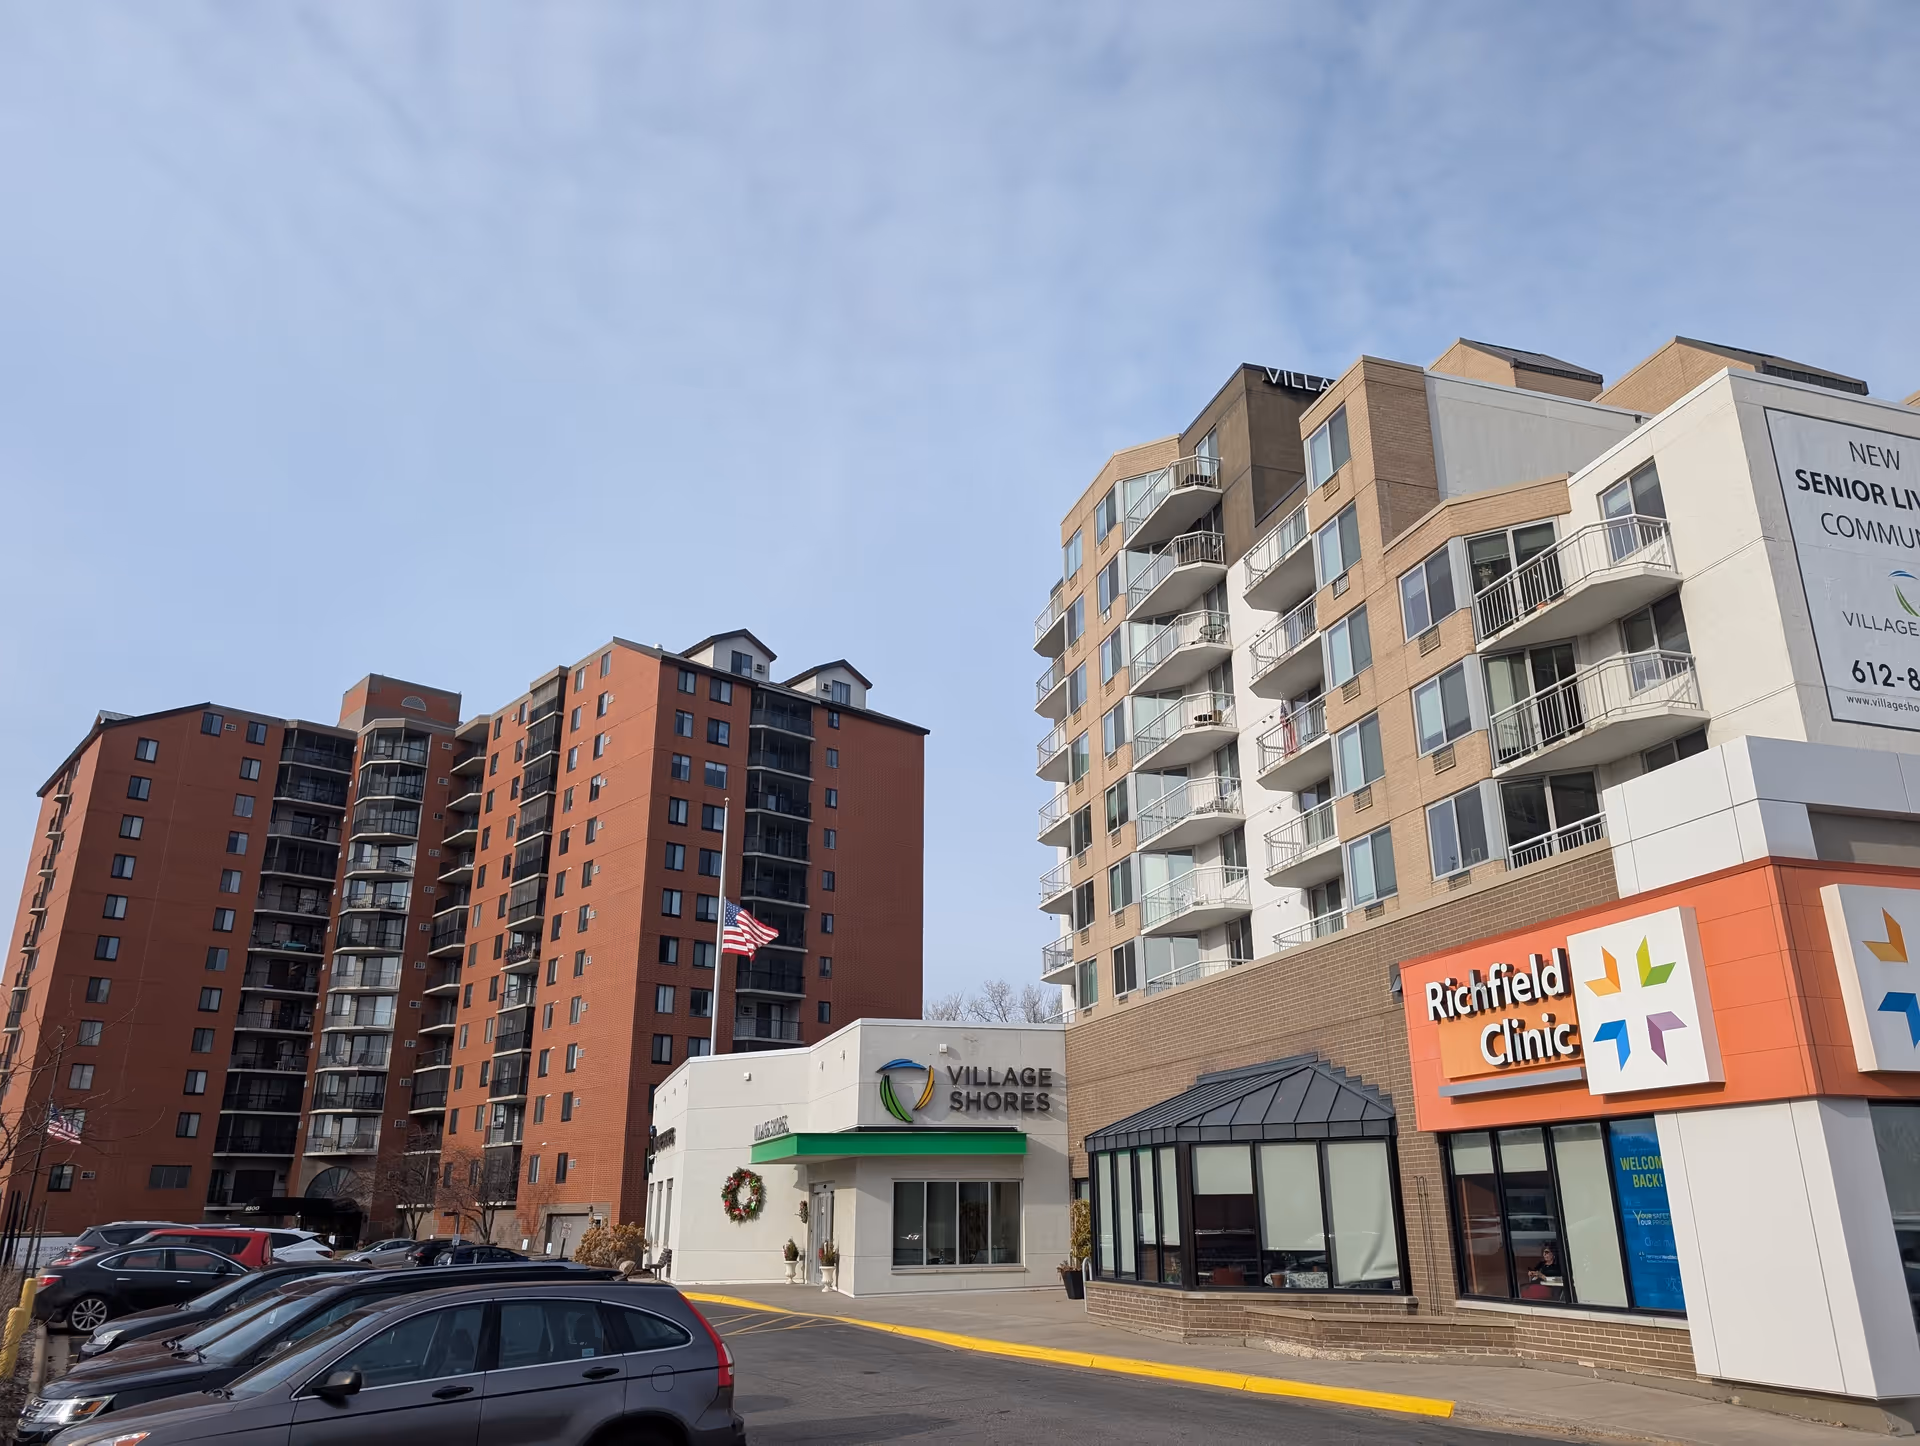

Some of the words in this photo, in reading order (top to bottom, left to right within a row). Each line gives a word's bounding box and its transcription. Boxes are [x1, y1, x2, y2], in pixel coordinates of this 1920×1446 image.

[1266, 367, 1330, 392] VILLA
[1848, 441, 1900, 471] NEW
[1795, 469, 1888, 506] SENIOR
[1842, 610, 1920, 637] VILLAGE
[1851, 660, 1920, 691] 612-8
[1425, 947, 1570, 1021] Richfield
[1480, 1012, 1577, 1066] Clinic
[946, 1065, 1053, 1088] VILLAGE
[949, 1091, 1051, 1112] SHORES
[1632, 1173, 1664, 1188] BACK!
